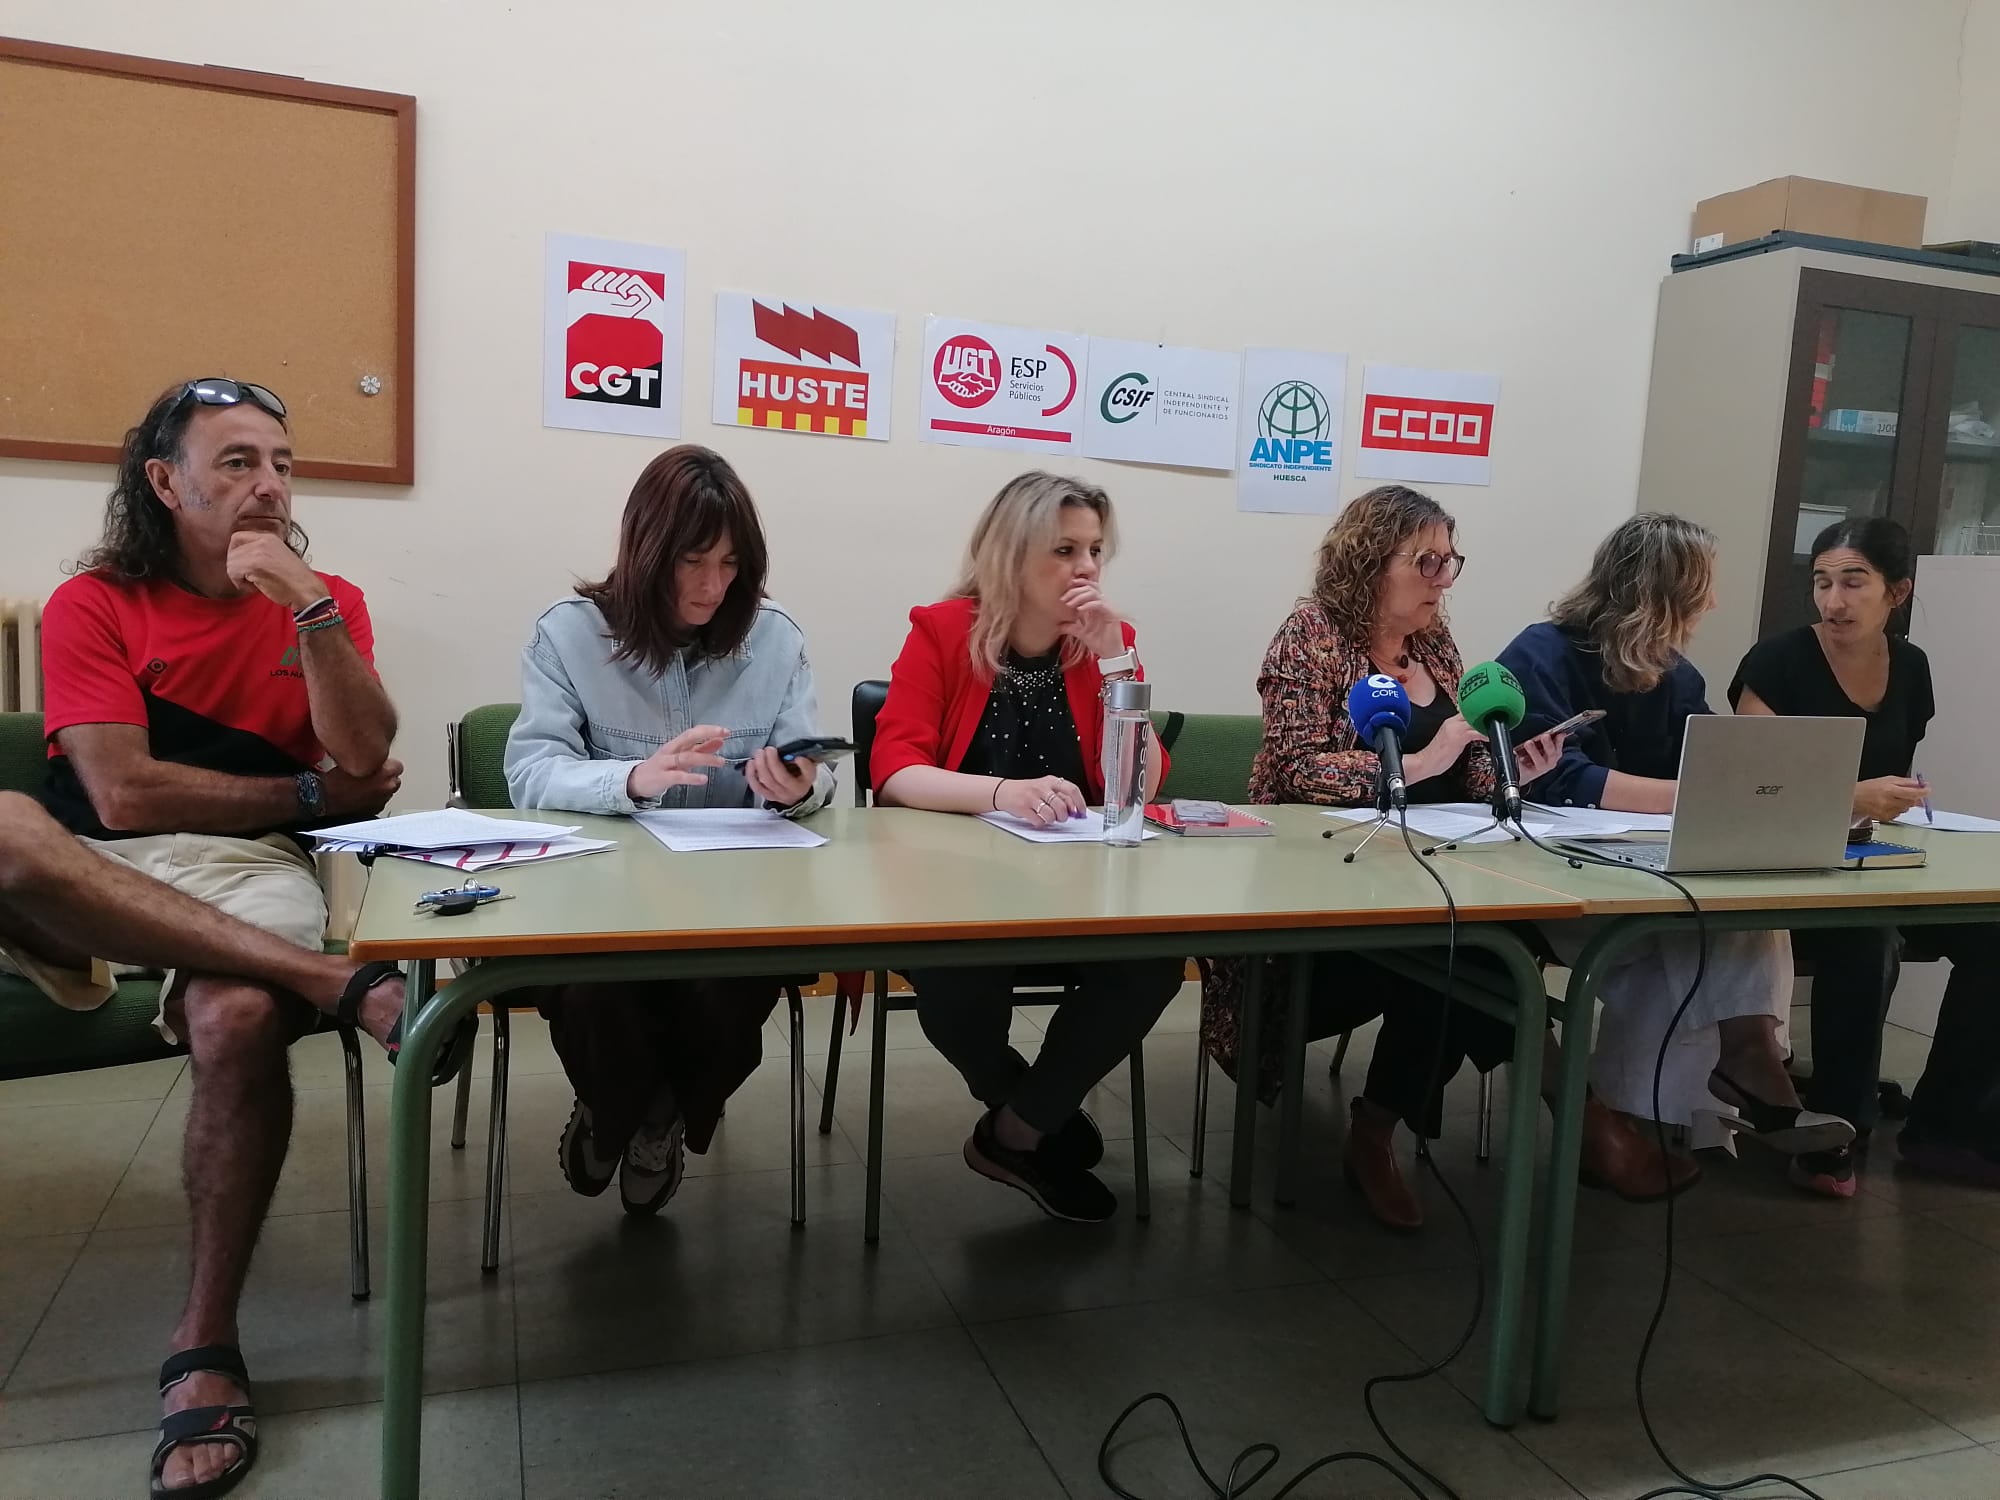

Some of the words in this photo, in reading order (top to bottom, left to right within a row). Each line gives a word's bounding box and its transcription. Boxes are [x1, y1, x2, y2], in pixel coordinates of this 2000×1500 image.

[941, 345, 994, 379] UGT
[570, 362, 658, 400] CGT
[1010, 380, 1044, 392] Servicios
[741, 371, 866, 409] HUSTE
[1009, 391, 1041, 402] Públicos
[1111, 387, 1155, 408] CSIF
[1164, 390, 1195, 399] CENTRAL
[1197, 394, 1229, 403] SINDICAL
[1163, 399, 1221, 411] INDEPENDIENTE
[1174, 409, 1229, 420] FUNCIONARIOS
[987, 425, 1016, 436] Aragón
[1372, 406, 1483, 444] CCOO
[1250, 437, 1333, 465] ANPE
[1249, 462, 1282, 470] SINDICATO
[1273, 474, 1307, 482] HUESCA
[270, 669, 289, 677] LOS
[1371, 689, 1400, 699] COPE
[1755, 785, 1784, 795] acer
